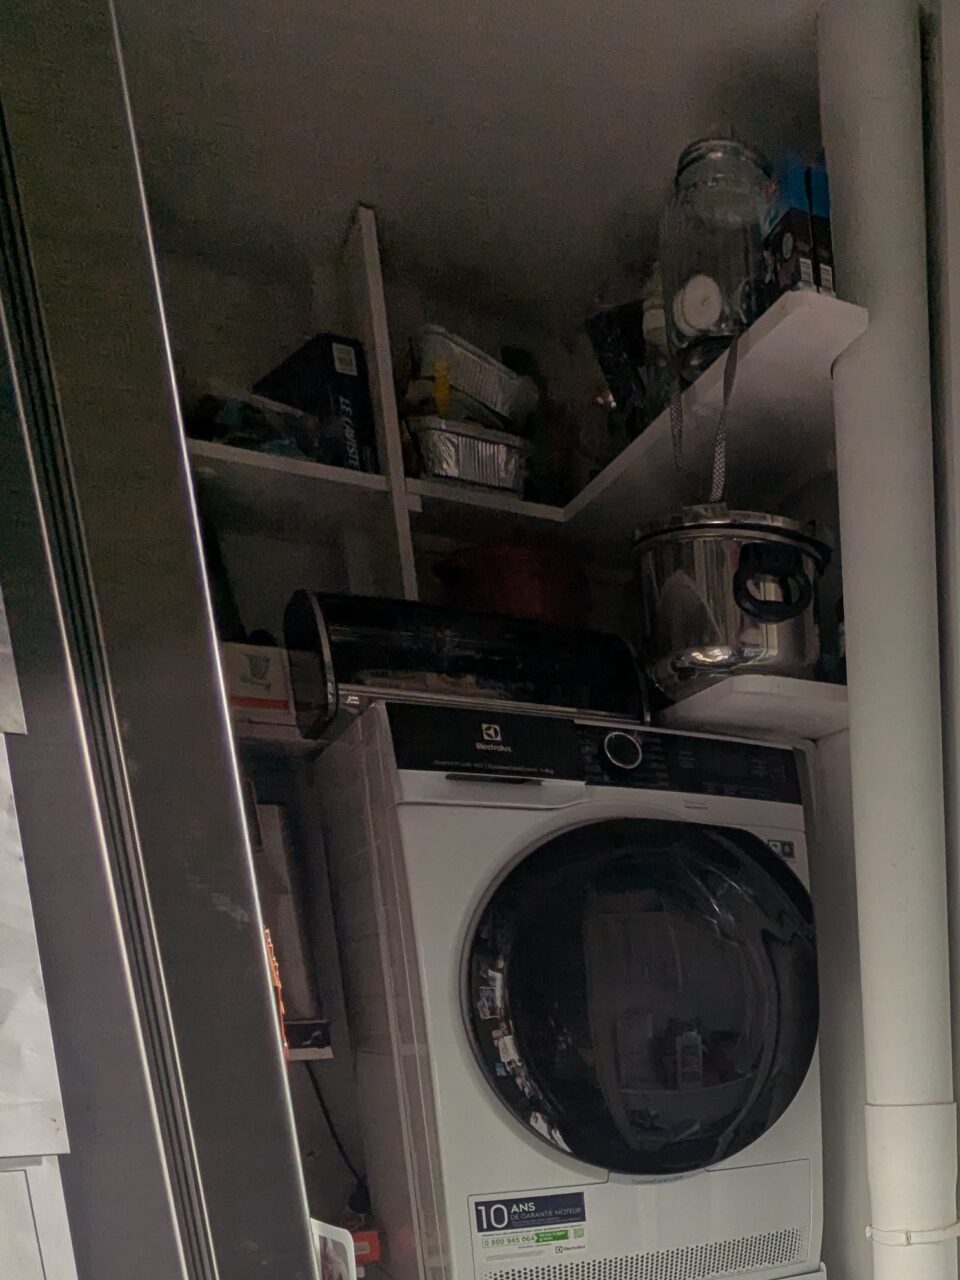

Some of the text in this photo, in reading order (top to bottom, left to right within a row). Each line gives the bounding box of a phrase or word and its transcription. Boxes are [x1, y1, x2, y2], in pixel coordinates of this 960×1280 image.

[475, 742, 512, 752] Electrolux
[511, 1202, 536, 1213] ANS
[520, 1210, 553, 1220] GARANTIE
[554, 1207, 582, 1216] MOTEUR
[478, 1204, 508, 1229] 10
